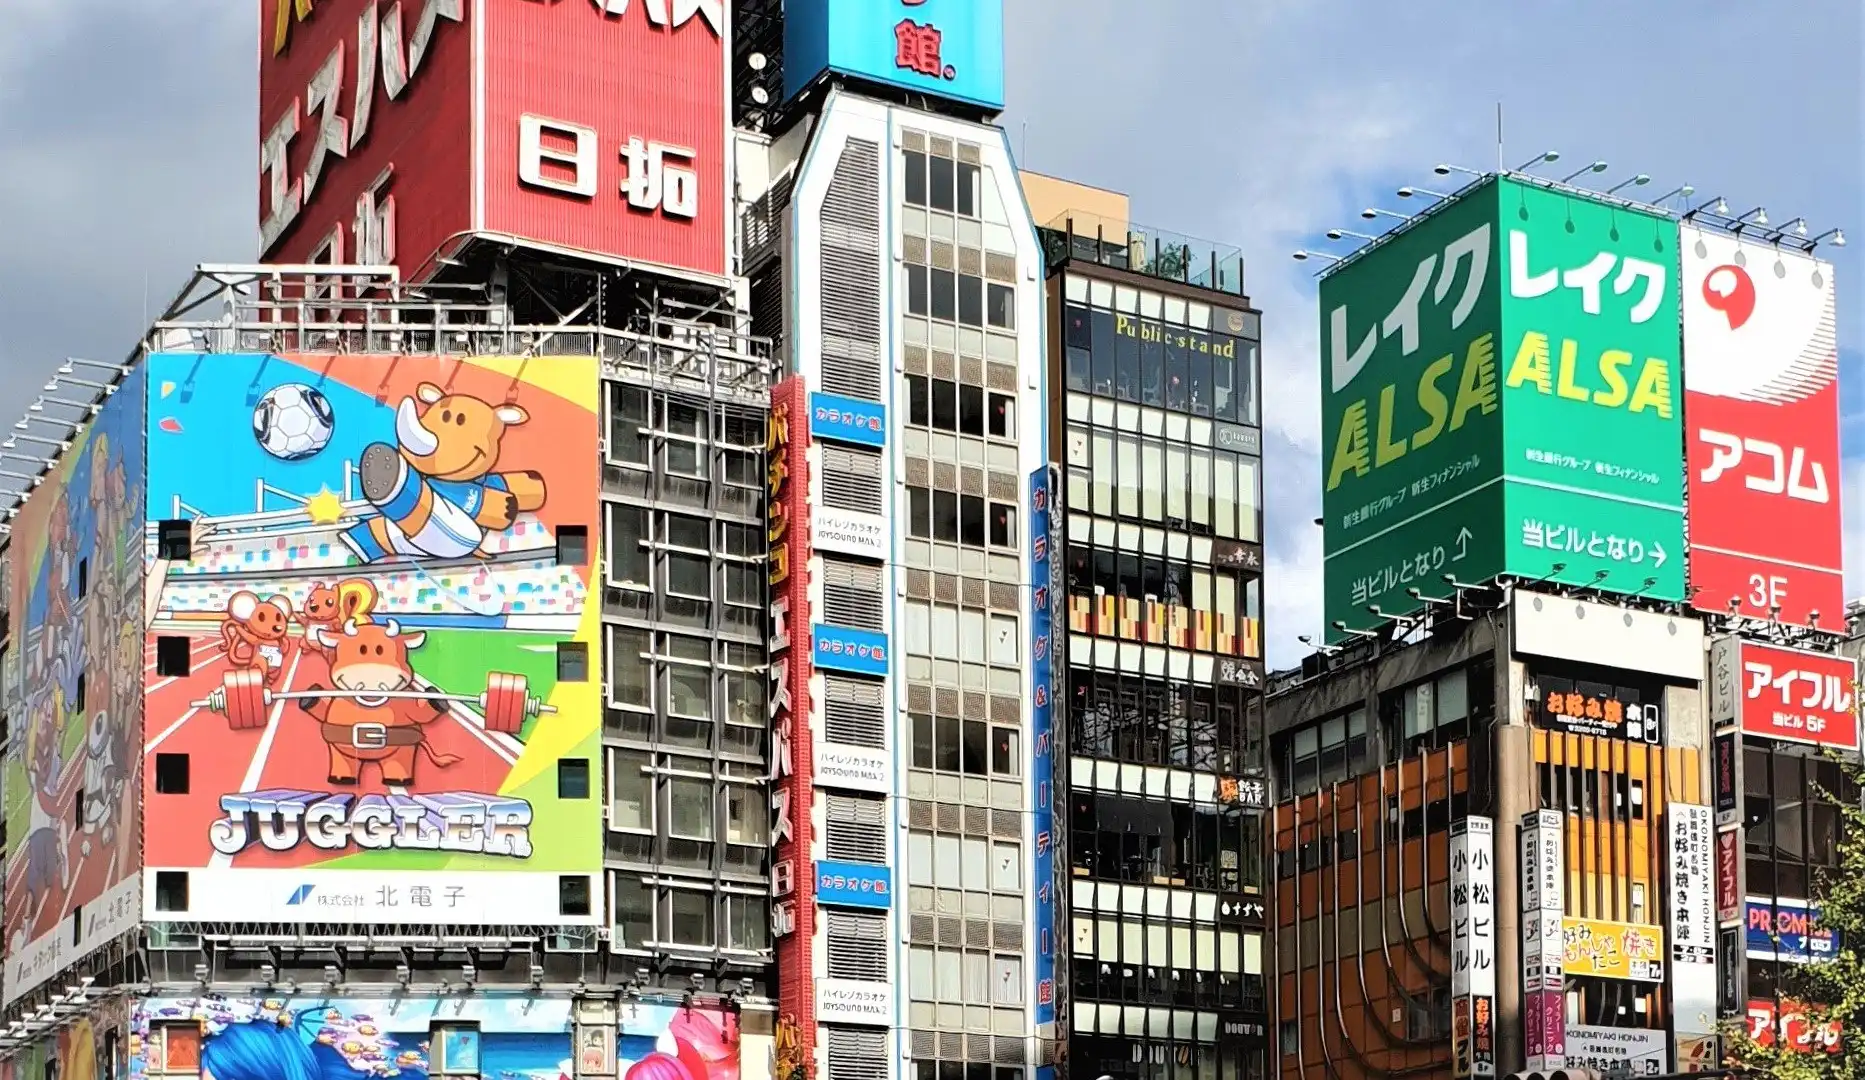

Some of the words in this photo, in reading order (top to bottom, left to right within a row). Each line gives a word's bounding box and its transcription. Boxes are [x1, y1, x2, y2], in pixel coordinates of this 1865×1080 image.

[518, 113, 698, 218] 日拓
[1331, 222, 1491, 393] レイク
[1509, 230, 1667, 323] レイク
[1116, 315, 1172, 345] Public
[1177, 339, 1235, 360] stand
[1506, 330, 1673, 418] ALSA
[1327, 331, 1498, 492] ALSA
[1343, 487, 1406, 530] 新生銀行グループ
[1411, 453, 1481, 497] 新生フィナンシャル
[1699, 428, 1829, 504] アコム
[1522, 518, 1645, 563] 当ビルとなり
[1352, 545, 1446, 606] 当ビルとなり
[1748, 574, 1788, 607] 3F
[1745, 661, 1851, 713] アイフル
[1772, 711, 1804, 729] 当ビル
[1806, 714, 1826, 733] 5F
[208, 789, 534, 859] JUGGLER
[1700, 810, 1709, 894] OKONOMIYAKI
[318, 895, 364, 907] 株式会社
[375, 884, 466, 908] 北電子
[1452, 849, 1469, 972] 小松ビル
[1472, 848, 1490, 971] 小松ビル
[1722, 850, 1735, 908] アイフル
[1702, 899, 1710, 943] HONJIN
[1592, 949, 1620, 970] たこ
[1618, 1033, 1649, 1043] HONJIN
